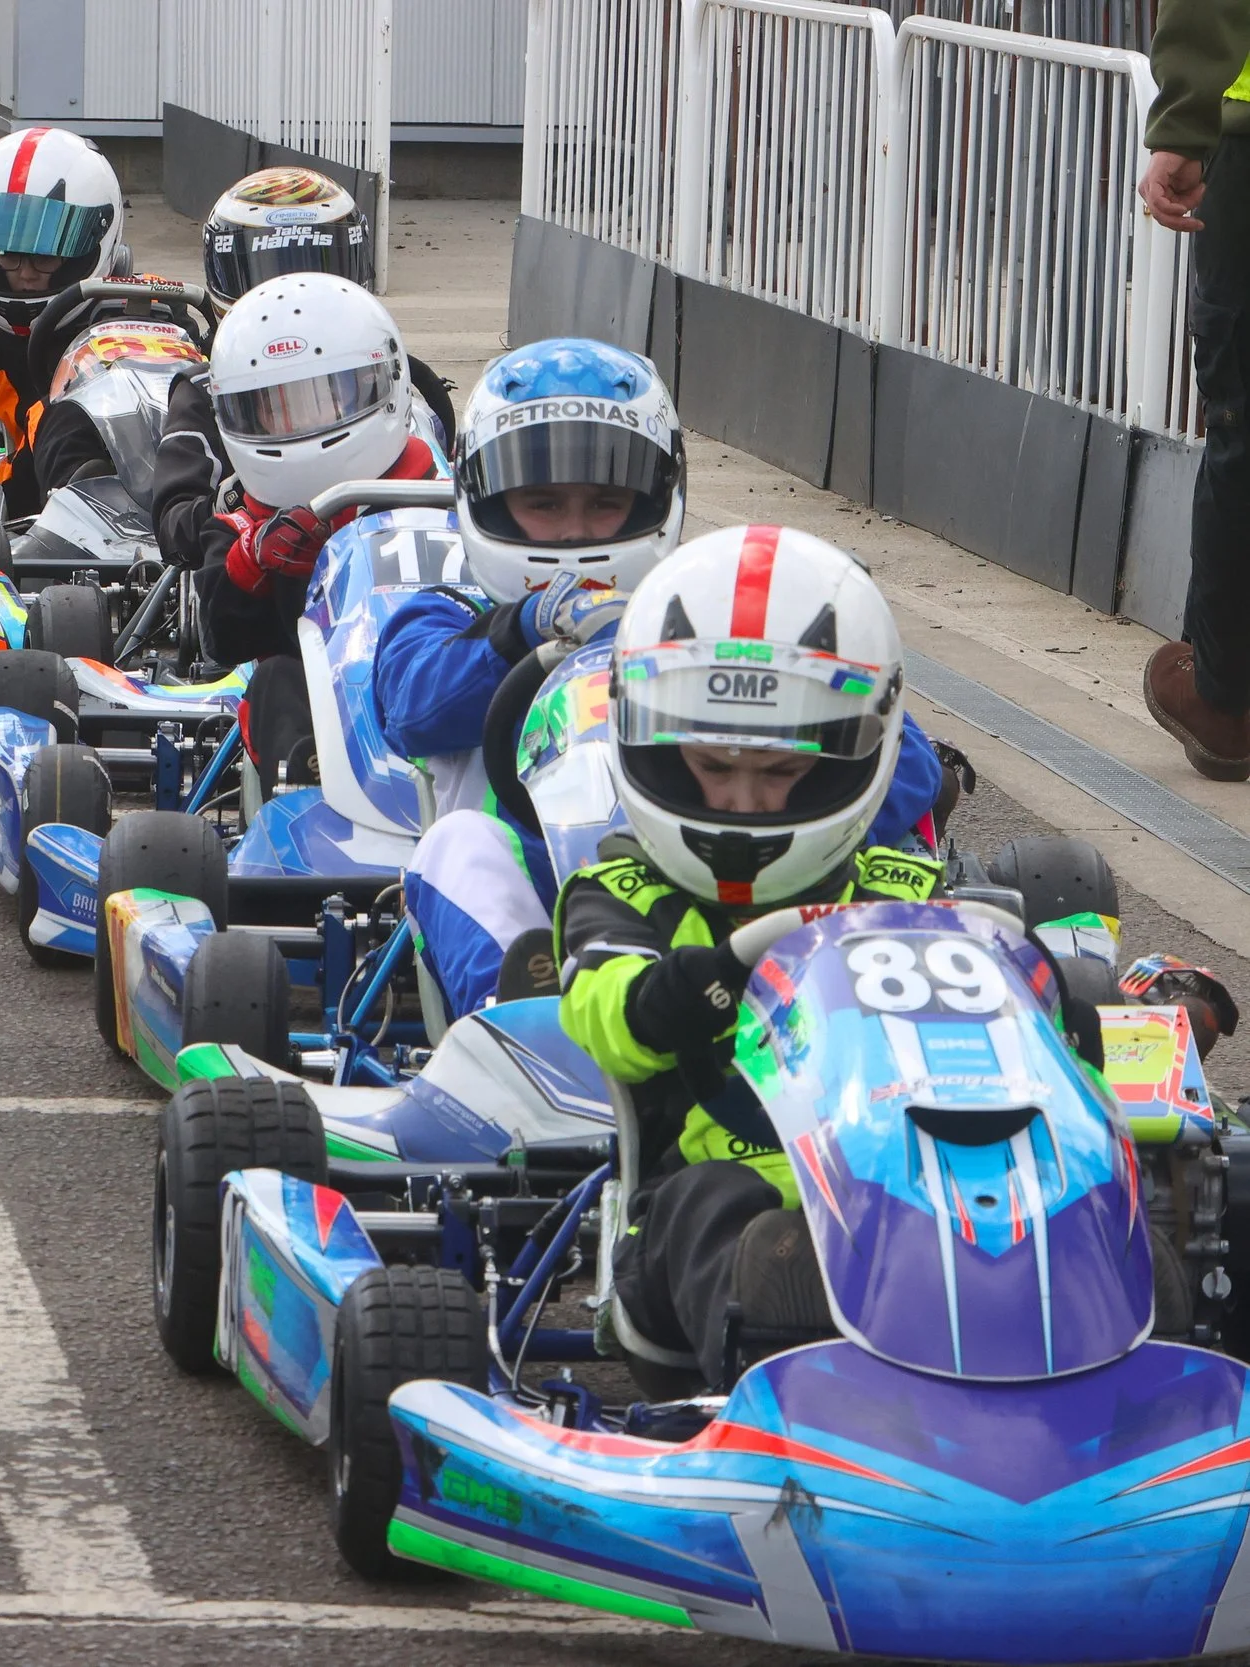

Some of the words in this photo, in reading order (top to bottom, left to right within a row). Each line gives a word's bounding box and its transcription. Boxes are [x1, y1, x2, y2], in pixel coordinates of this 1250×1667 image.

[251, 231, 333, 252] Harris
[272, 226, 312, 237] Jake
[348, 225, 363, 245] 22
[214, 234, 234, 253] 22
[150, 283, 185, 295] Racing
[268, 340, 301, 355] BELL
[495, 401, 639, 433] PETRONAS
[380, 530, 466, 583] 17
[707, 672, 779, 700] OMP
[868, 867, 925, 889] OMP
[847, 940, 1007, 1013] 89
